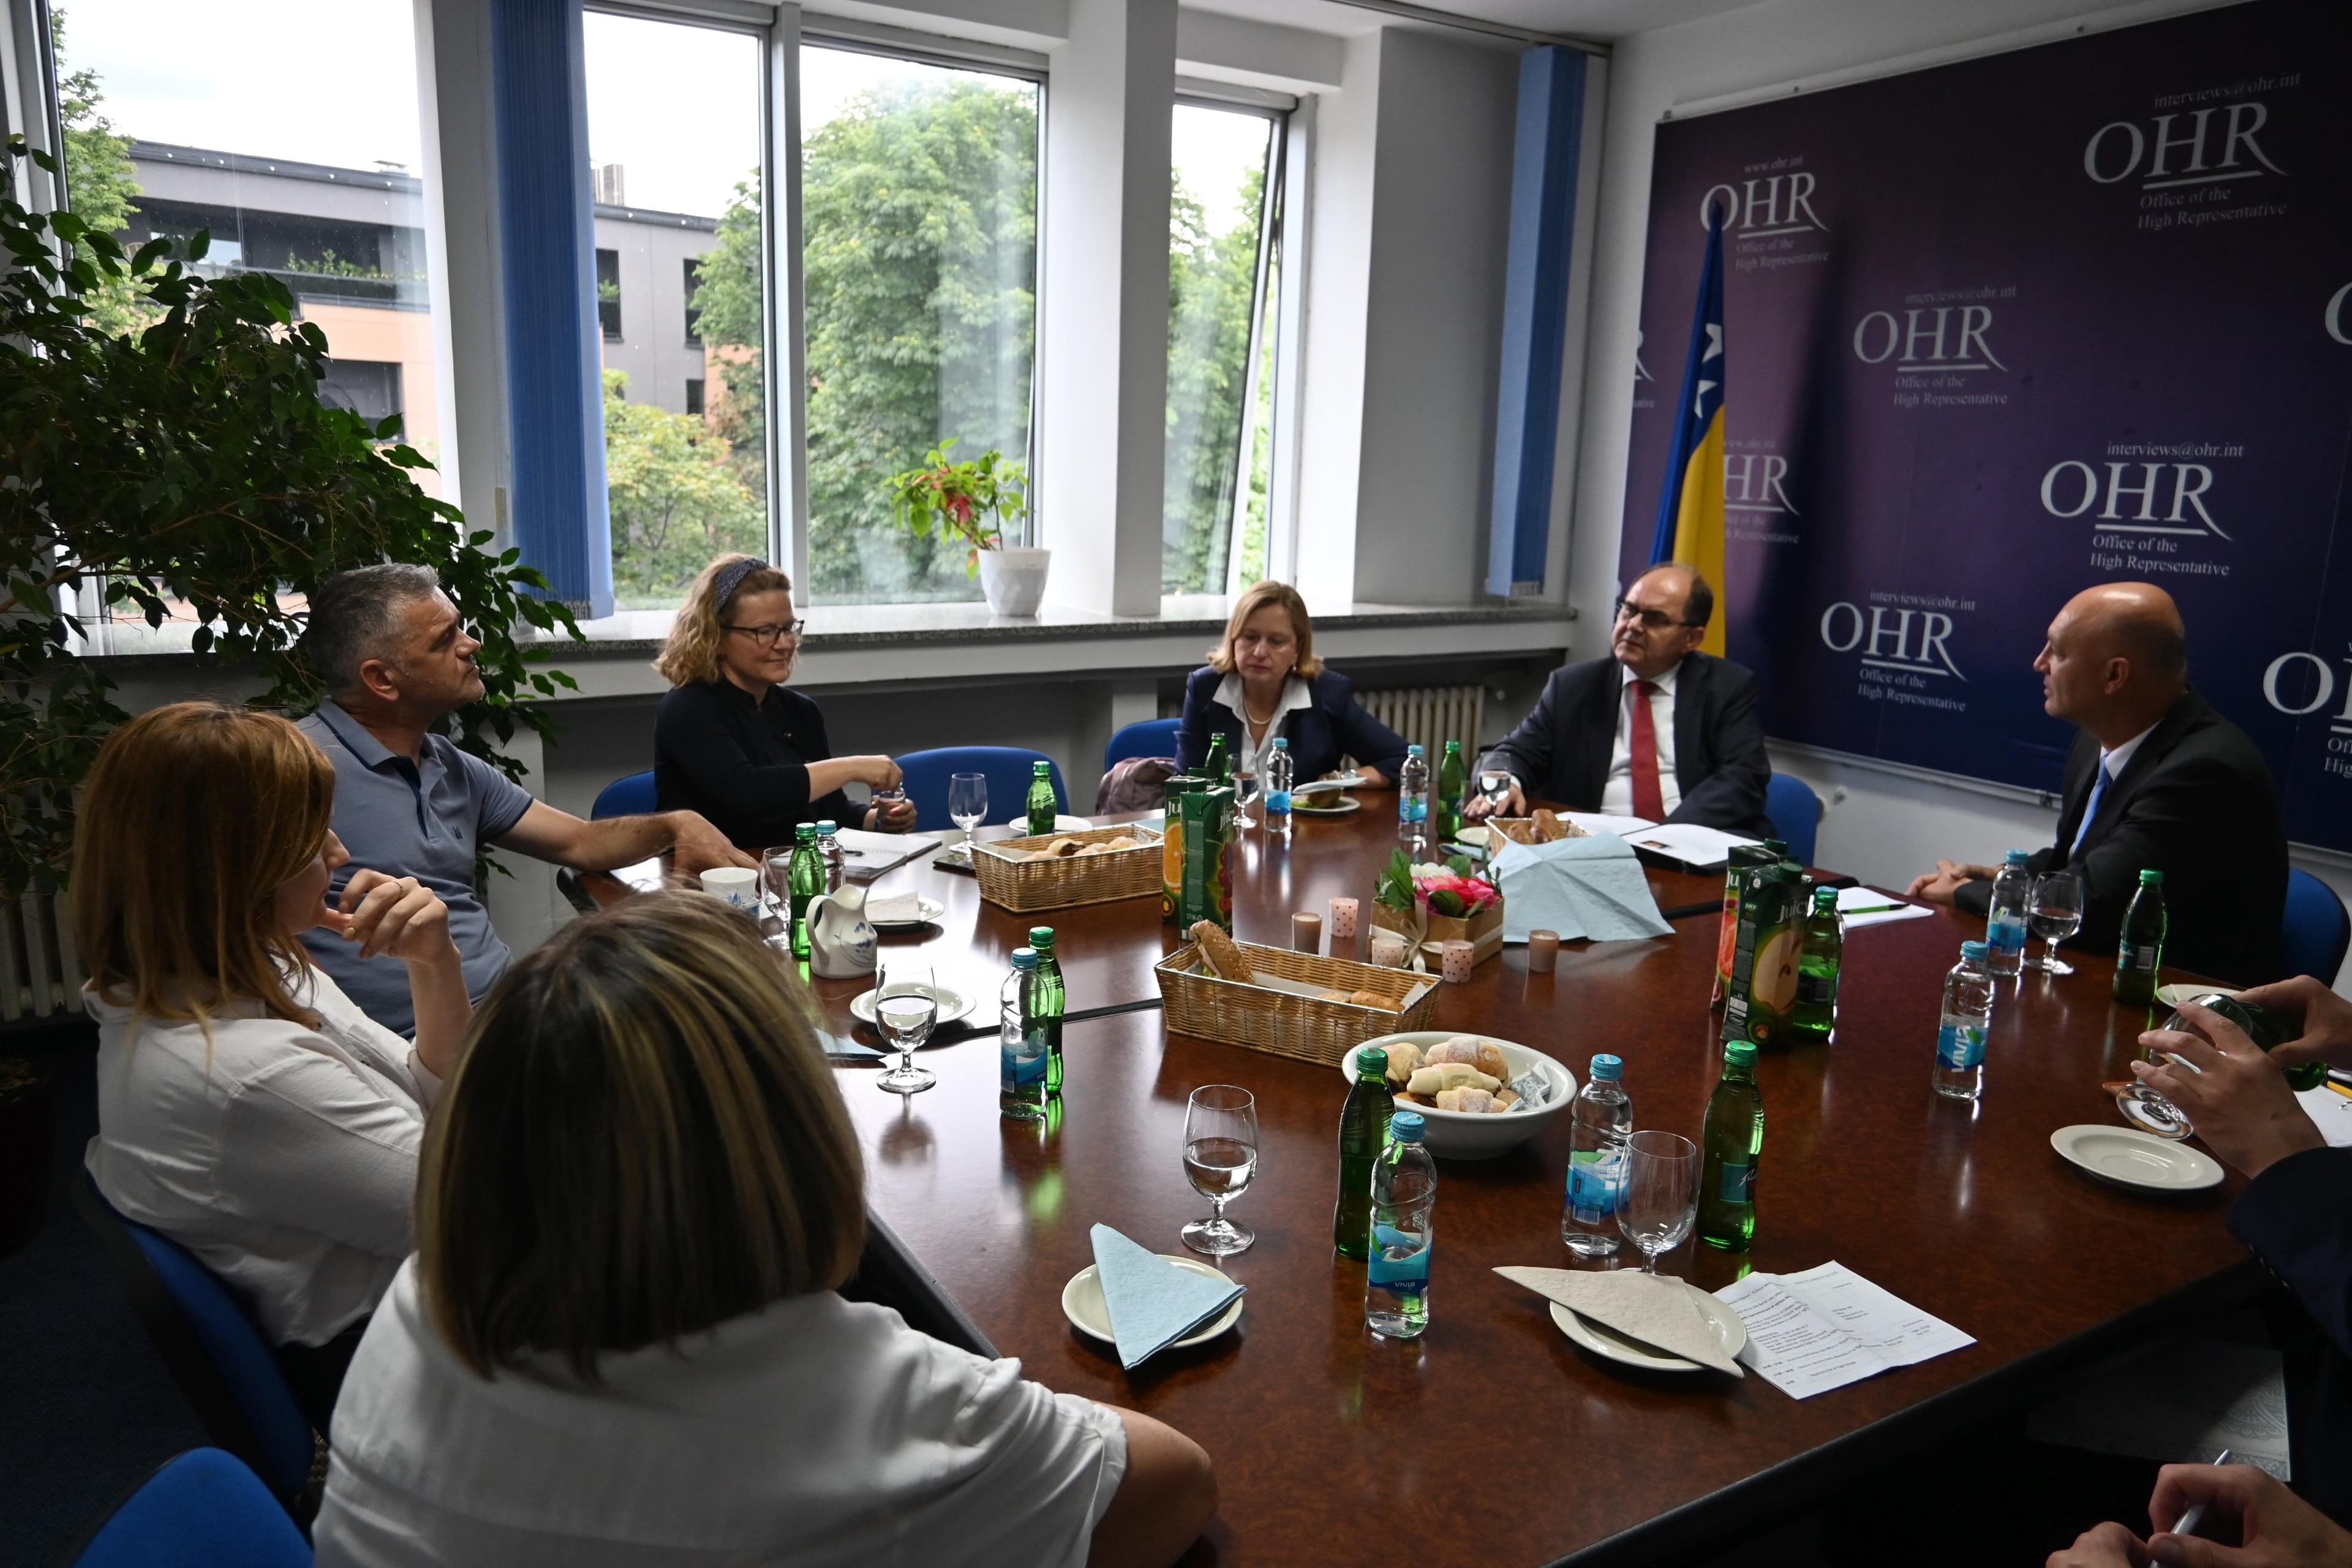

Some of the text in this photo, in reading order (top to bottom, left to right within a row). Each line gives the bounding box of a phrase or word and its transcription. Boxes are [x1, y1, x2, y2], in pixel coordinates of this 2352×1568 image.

[2154, 73, 2302, 108] interviews@ohr.int
[2084, 102, 2291, 184] OHR
[1700, 172, 1830, 233] OHR
[2140, 187, 2230, 209] Office of the
[2138, 202, 2288, 232] High Representative
[1736, 238, 1794, 254] Office of the
[1736, 252, 1830, 271] High Representative
[1853, 305, 2009, 372] OHR
[1894, 374, 1965, 388] Office of the
[1893, 392, 2008, 408] High Representative
[2107, 441, 2244, 459] interviews@ohr.int
[1724, 454, 1801, 517] HR
[2040, 461, 2235, 543] OHR
[2092, 534, 2177, 553] Office of the
[2090, 552, 2231, 576] High Representative
[1870, 589, 1976, 611] interviews@ohr.int
[1820, 601, 1970, 684] OHR
[1859, 668, 1927, 689] Office of the
[1858, 684, 1967, 712] High Representative
